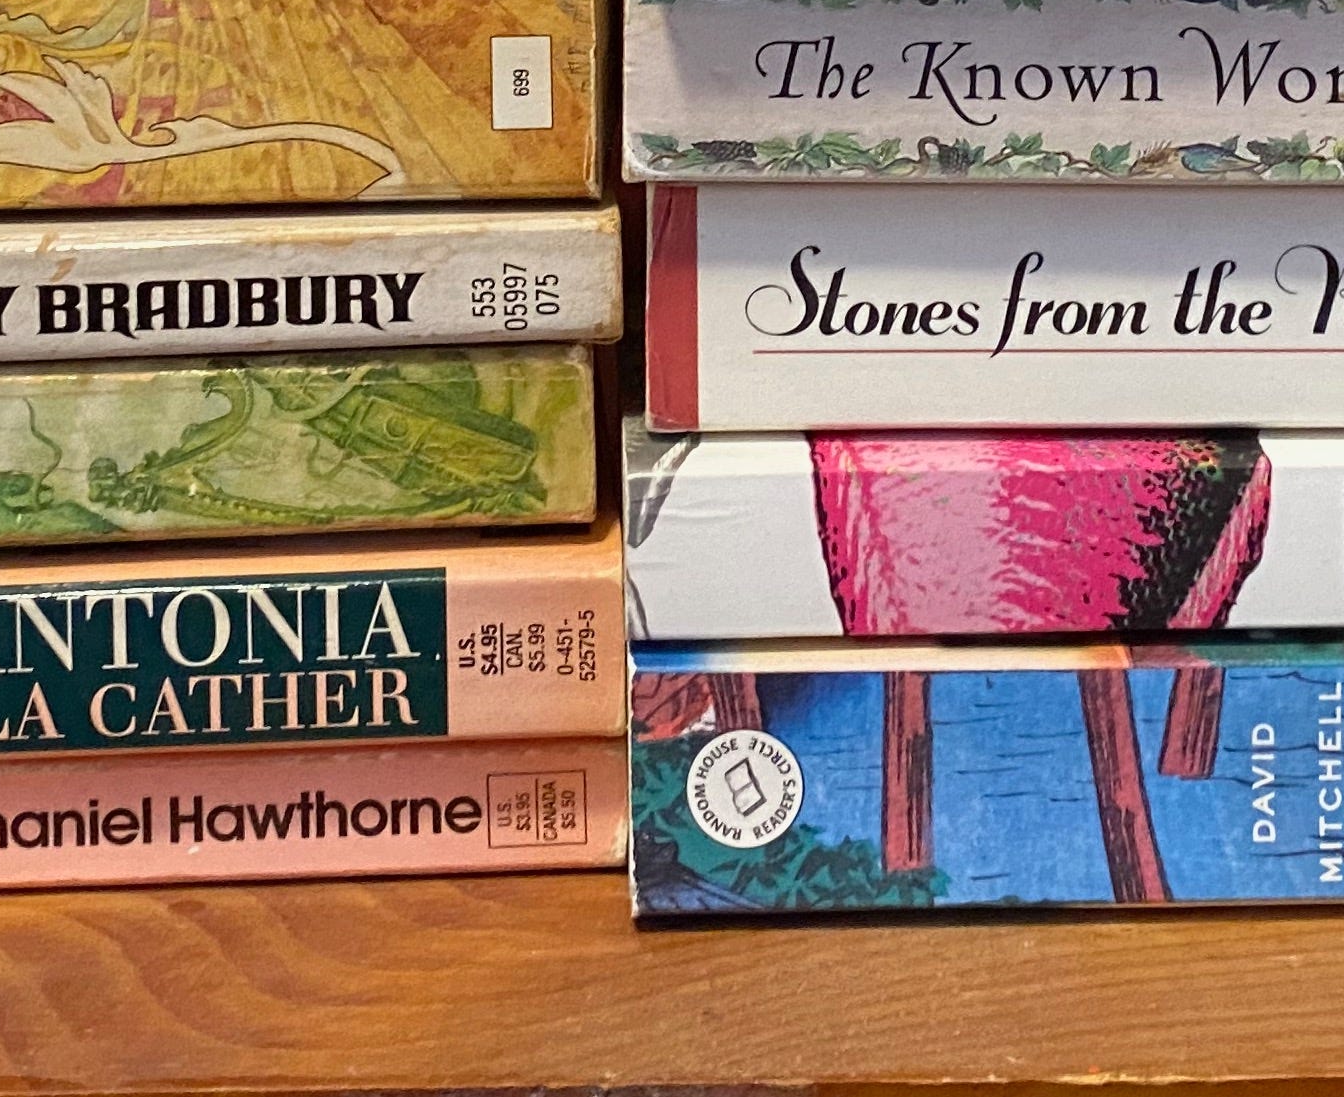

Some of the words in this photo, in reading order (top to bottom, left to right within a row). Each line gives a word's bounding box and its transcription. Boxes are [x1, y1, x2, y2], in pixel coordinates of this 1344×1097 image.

[754, 34, 875, 102] The
[903, 39, 1163, 126] Known
[35, 272, 425, 337] BRADBURY
[472, 277, 496, 317] 553
[503, 262, 528, 331] 05997
[535, 274, 560, 315] 075
[745, 244, 980, 337] Stones
[990, 251, 1148, 358] from
[1173, 258, 1272, 336] the
[459, 633, 476, 668] U.S.
[482, 624, 498, 675] $4.95
[506, 628, 523, 668] CAN.
[529, 624, 546, 672] $5.99
[557, 619, 574, 675] 0-451-
[579, 610, 596, 681] 52579-5
[88, 667, 418, 738] CATHER
[696, 738, 739, 780] HOUSE
[748, 737, 792, 775] CIRCLE
[1253, 721, 1277, 843] DAVID
[1320, 679, 1344, 883] MITCHELL
[170, 791, 482, 845] Hawthorne
[496, 799, 512, 827] U.S.
[517, 792, 531, 831] $3.95
[542, 781, 558, 841] CANADA
[694, 783, 742, 841] RANDOM
